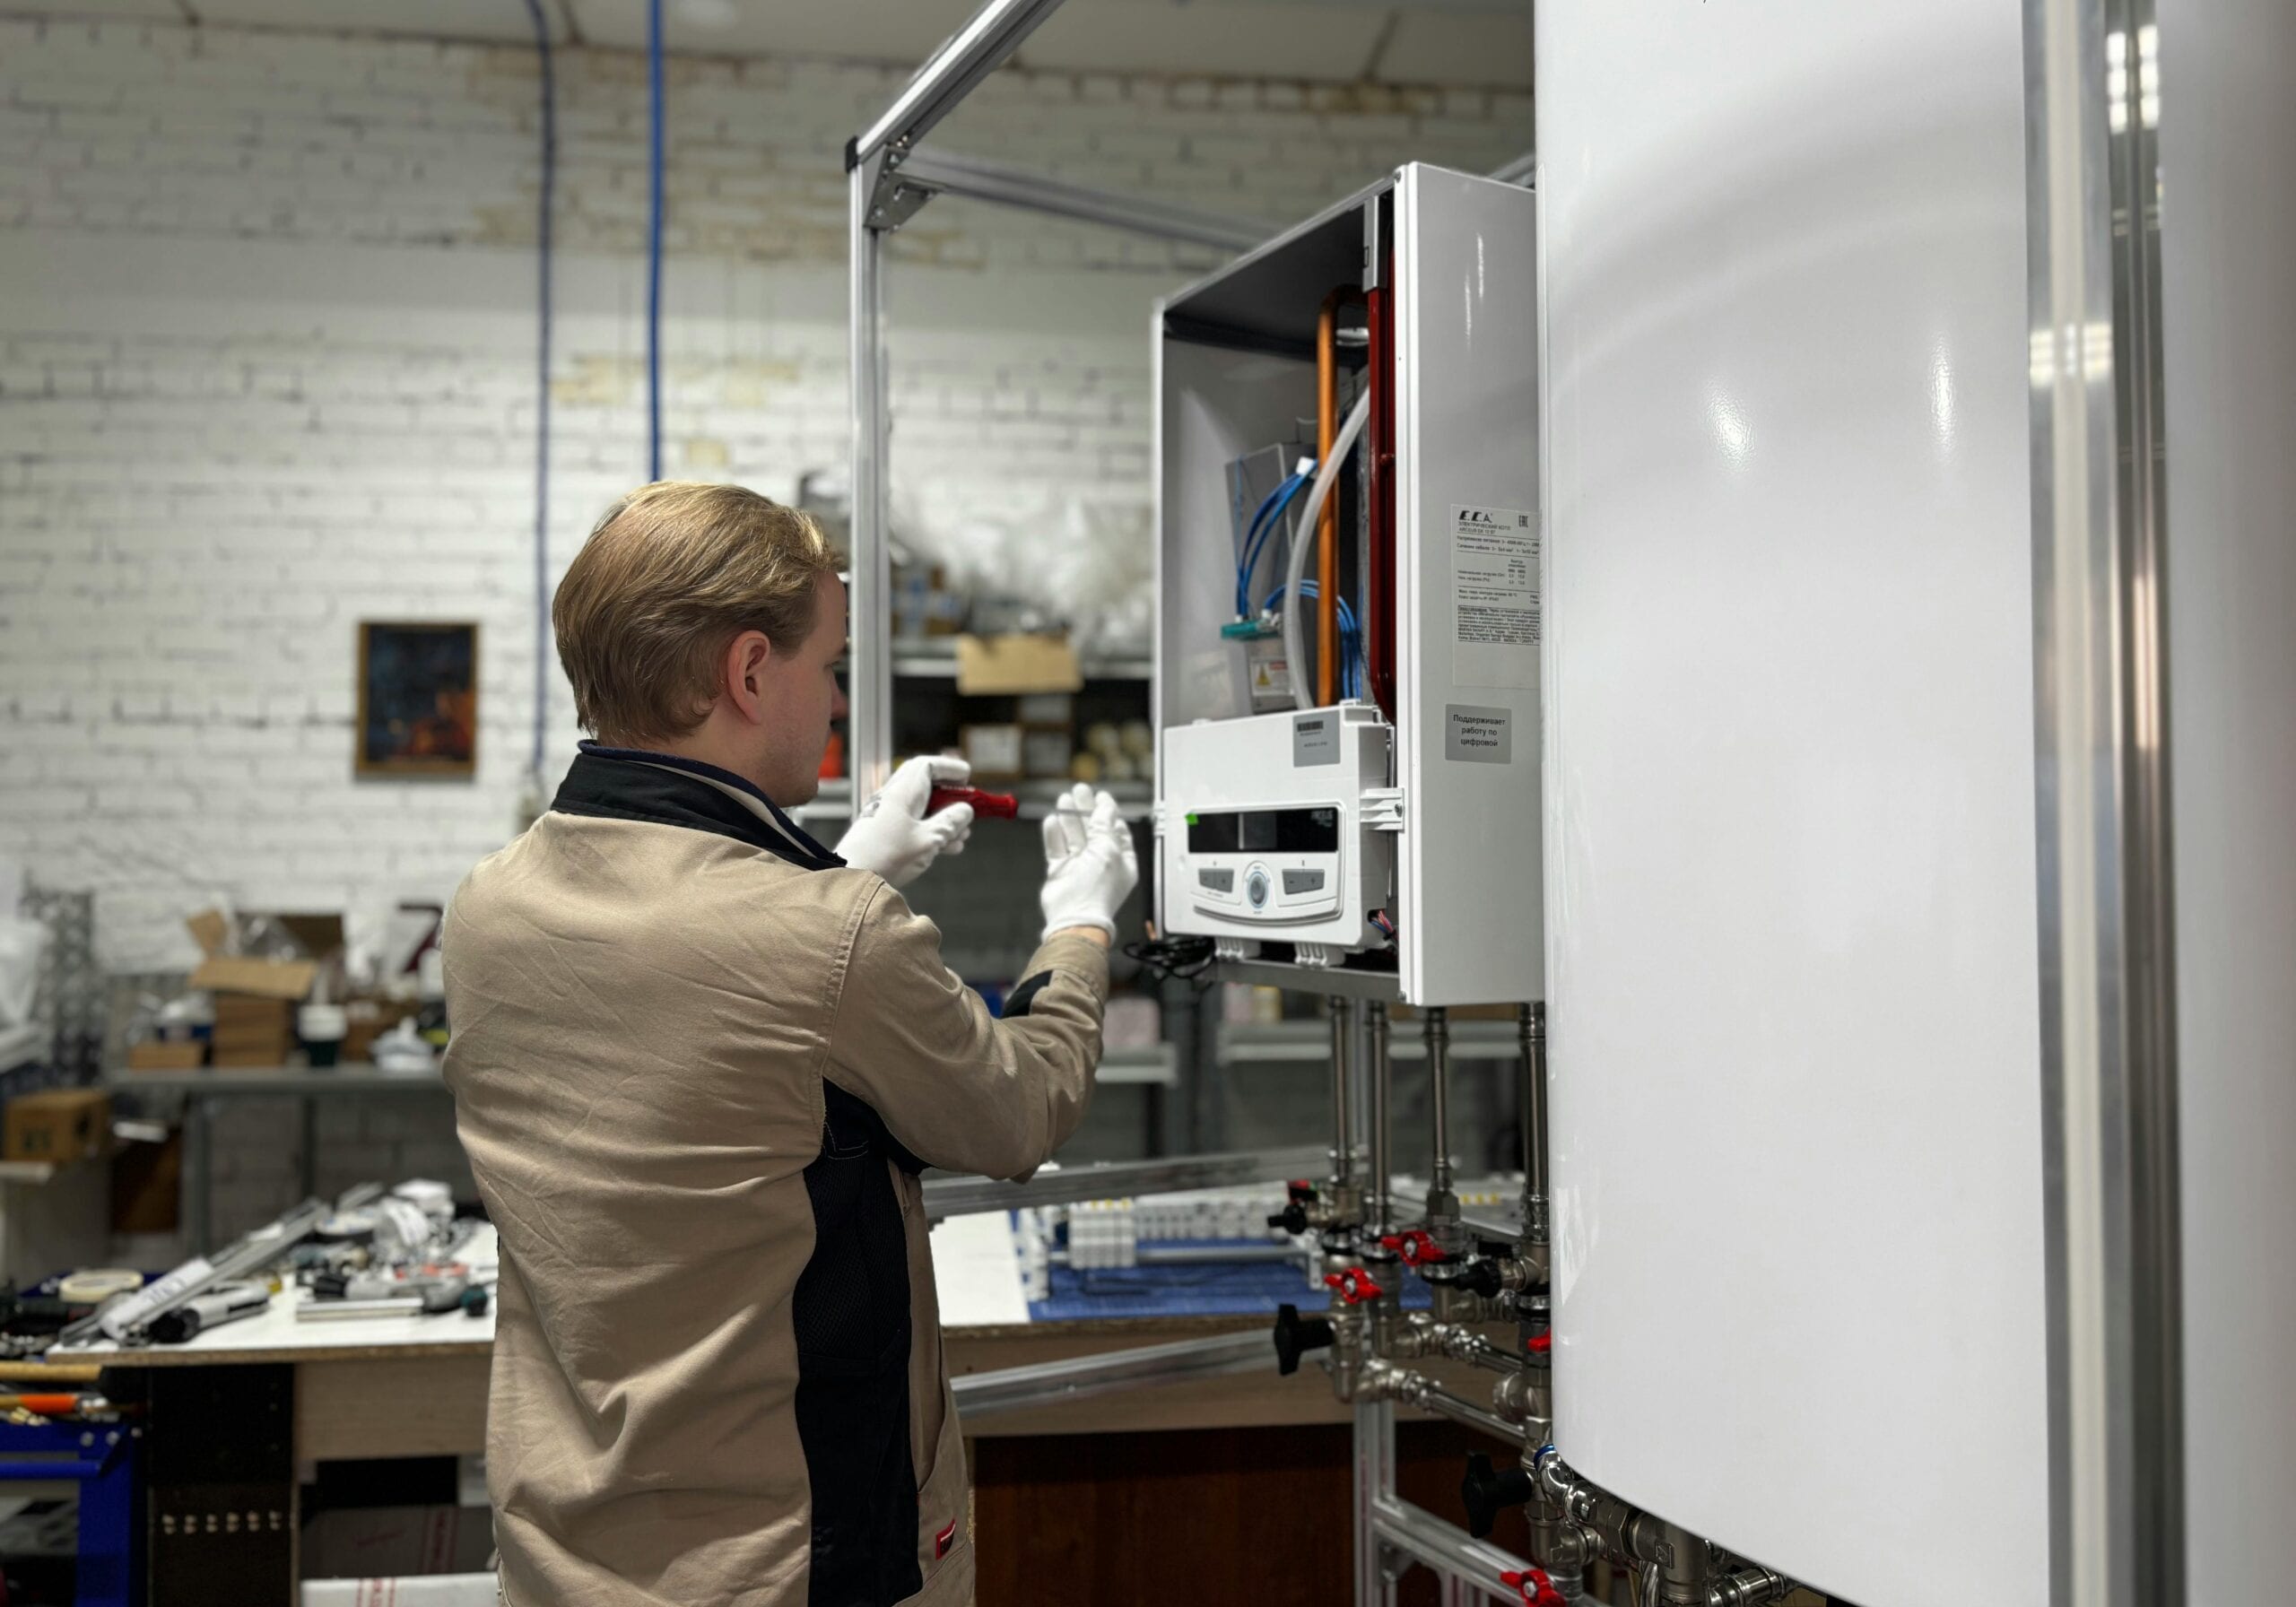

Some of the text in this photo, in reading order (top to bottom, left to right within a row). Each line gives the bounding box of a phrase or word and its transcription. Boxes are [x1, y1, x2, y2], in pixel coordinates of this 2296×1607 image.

[1453, 714, 1506, 725] Поддерживает
[1461, 726, 1486, 737] работу
[1460, 737, 1499, 748] цифровой
